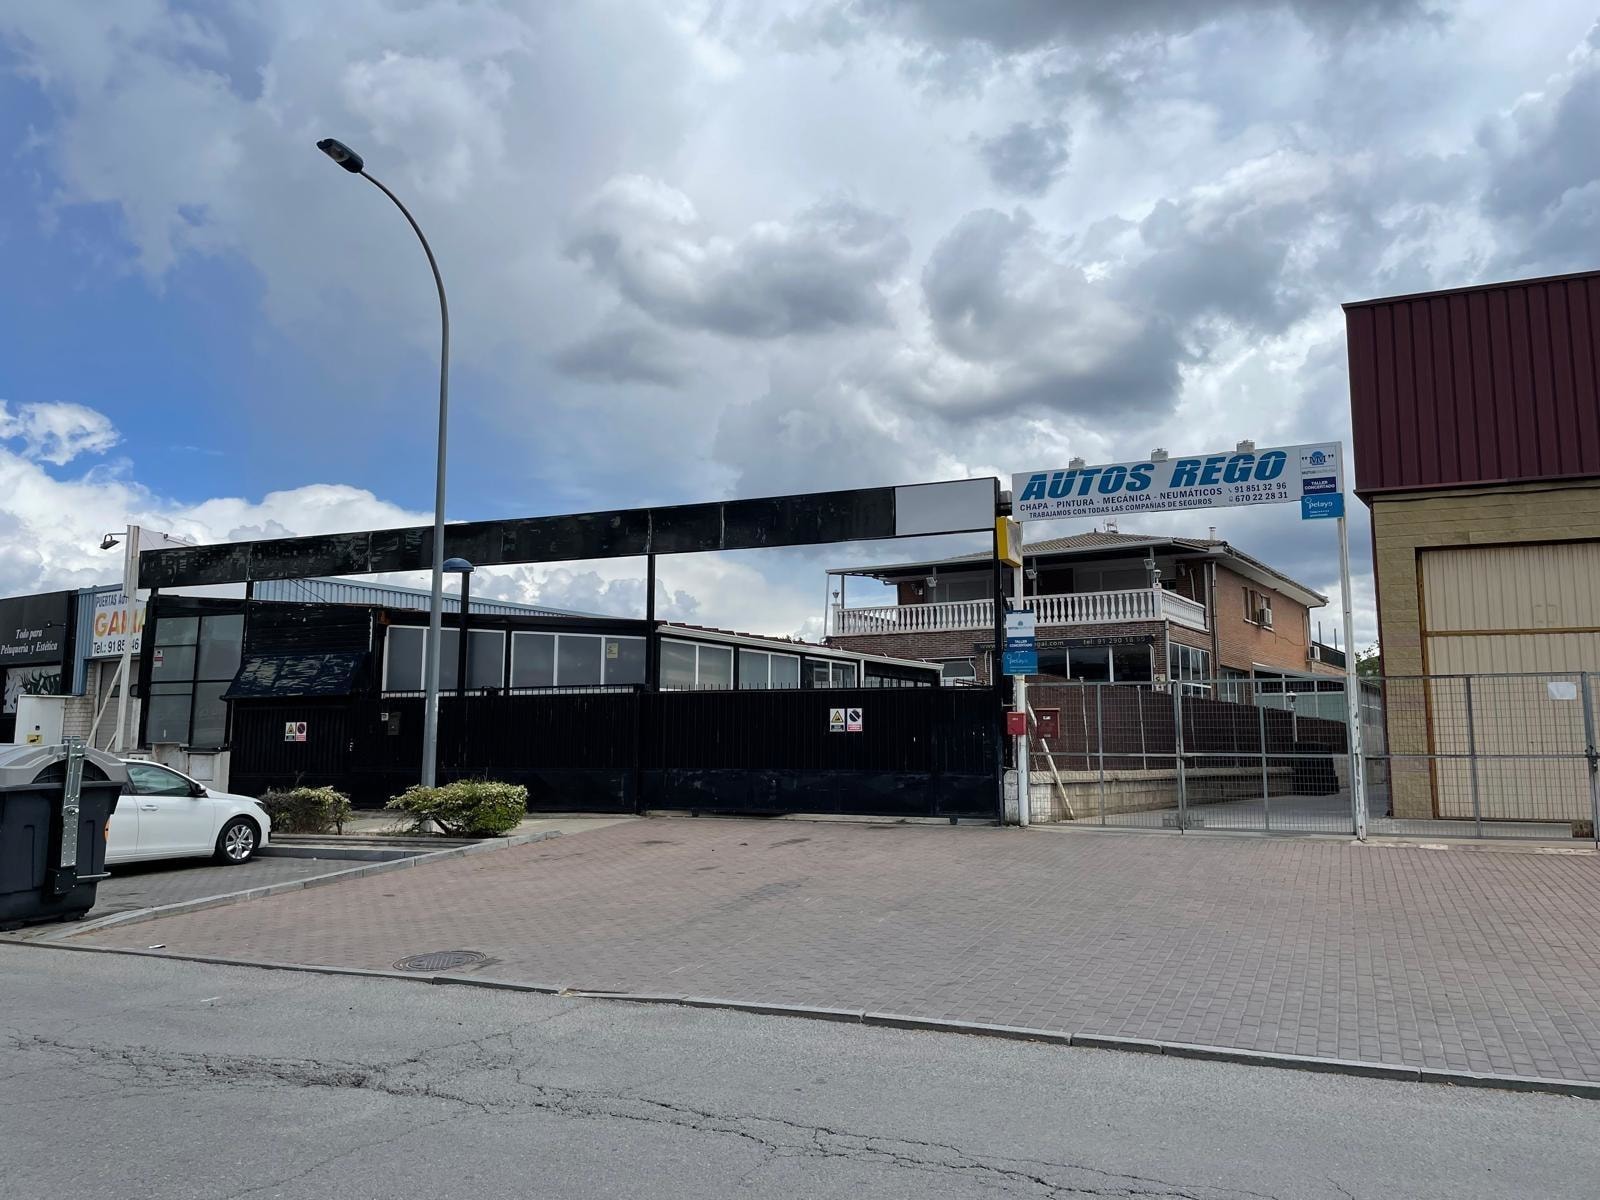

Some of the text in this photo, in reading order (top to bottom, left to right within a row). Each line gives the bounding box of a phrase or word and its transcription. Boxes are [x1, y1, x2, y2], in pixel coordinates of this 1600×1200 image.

[1020, 450, 1287, 501] AUTOS REGO
[1234, 481, 1287, 494] 91 851 32 96
[1020, 502, 1048, 512] CHAPA
[1056, 498, 1094, 508] PINTURA
[1103, 493, 1150, 505] MECÁNICA
[1160, 487, 1223, 500] NEUMÁTICOS
[1235, 491, 1288, 503] 670 22 28 31
[1030, 510, 1071, 519] TRABAJAMOS
[1088, 505, 1110, 514] TODAS
[1112, 504, 1124, 512] LAS
[1167, 500, 1177, 508] DE
[1178, 498, 1213, 507] SEGUROS
[16, 629, 29, 640] Todo
